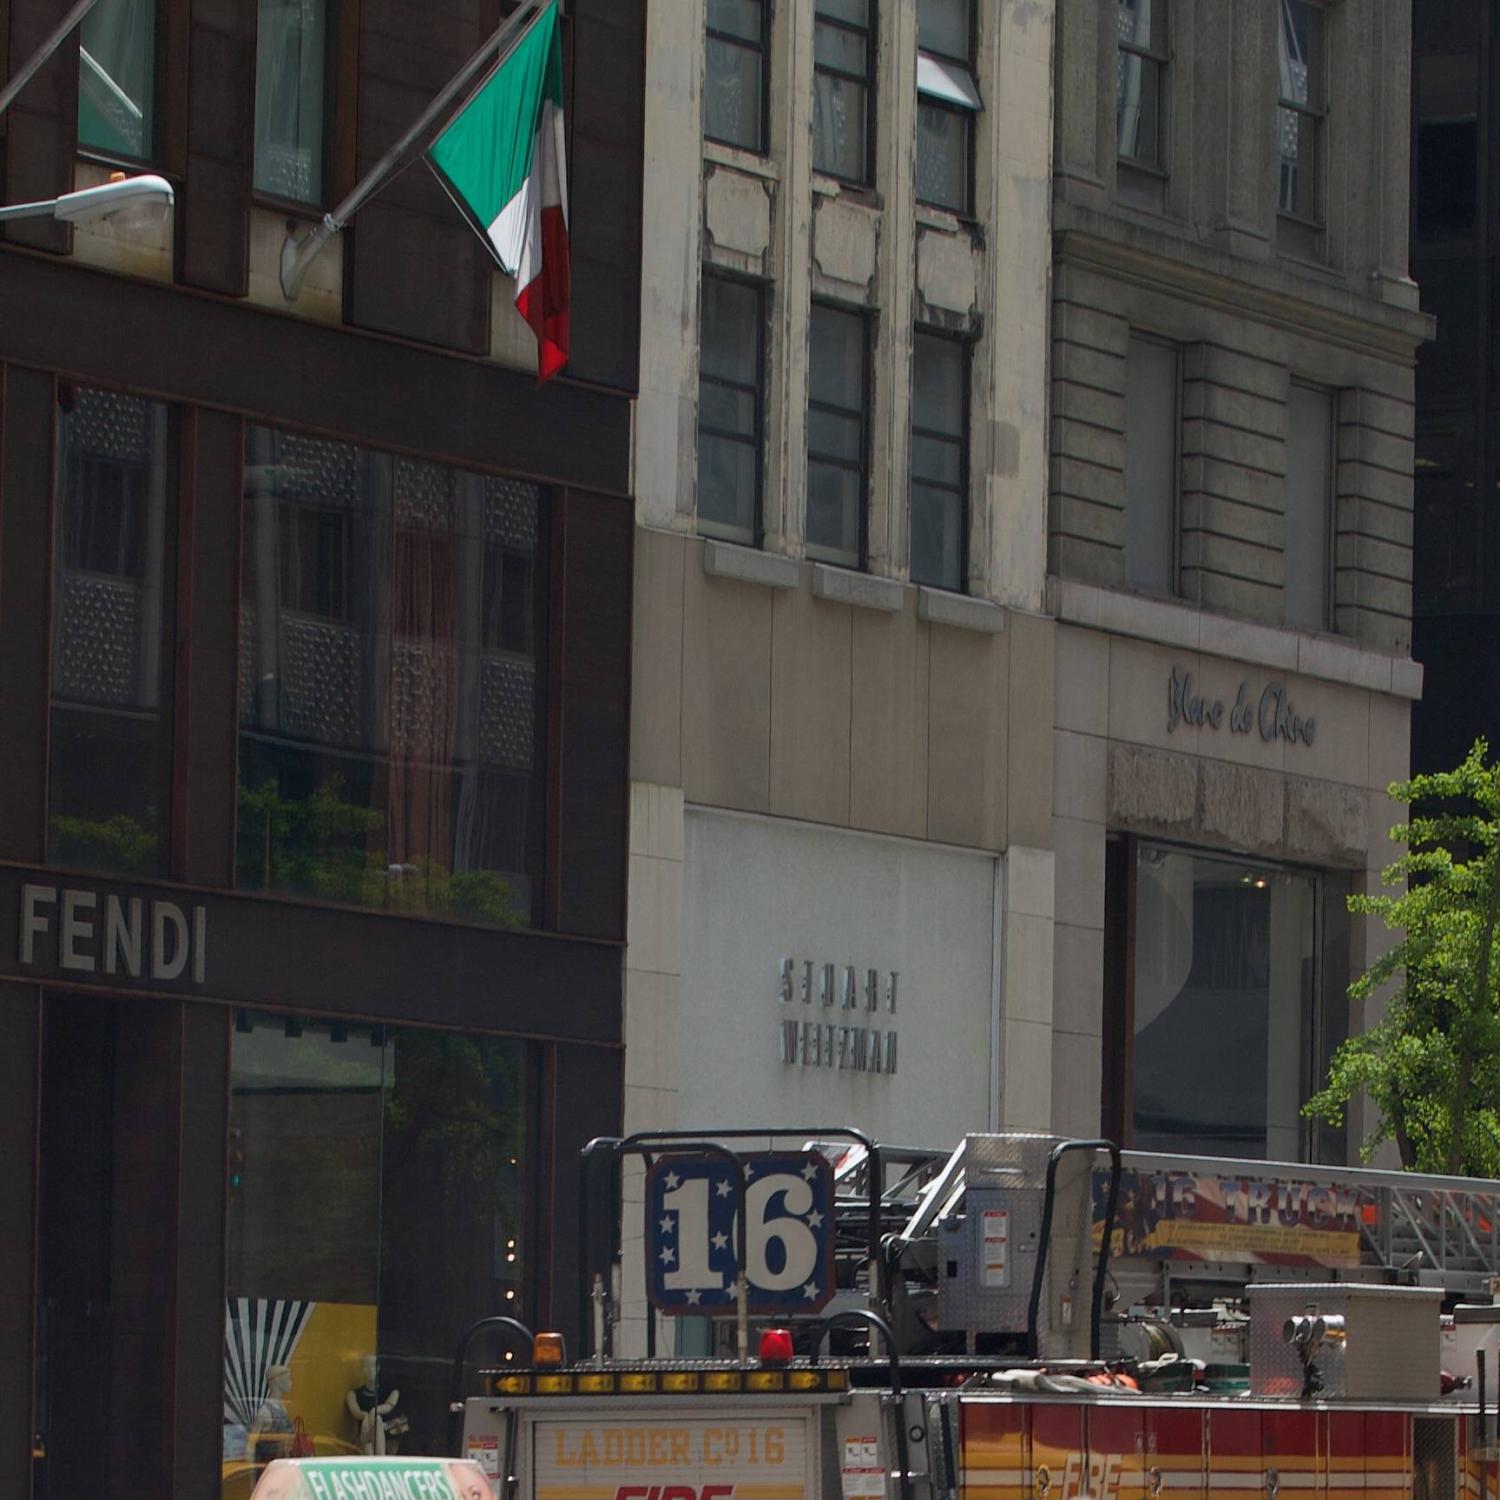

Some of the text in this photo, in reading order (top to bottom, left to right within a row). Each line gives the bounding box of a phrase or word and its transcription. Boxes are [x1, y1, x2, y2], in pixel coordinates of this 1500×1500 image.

[20, 883, 207, 984] FENDI
[662, 1173, 818, 1292] 16
[1221, 1179, 1361, 1231] TRUCK
[553, 1429, 698, 1466] LADDER
[747, 1427, 785, 1465] 16
